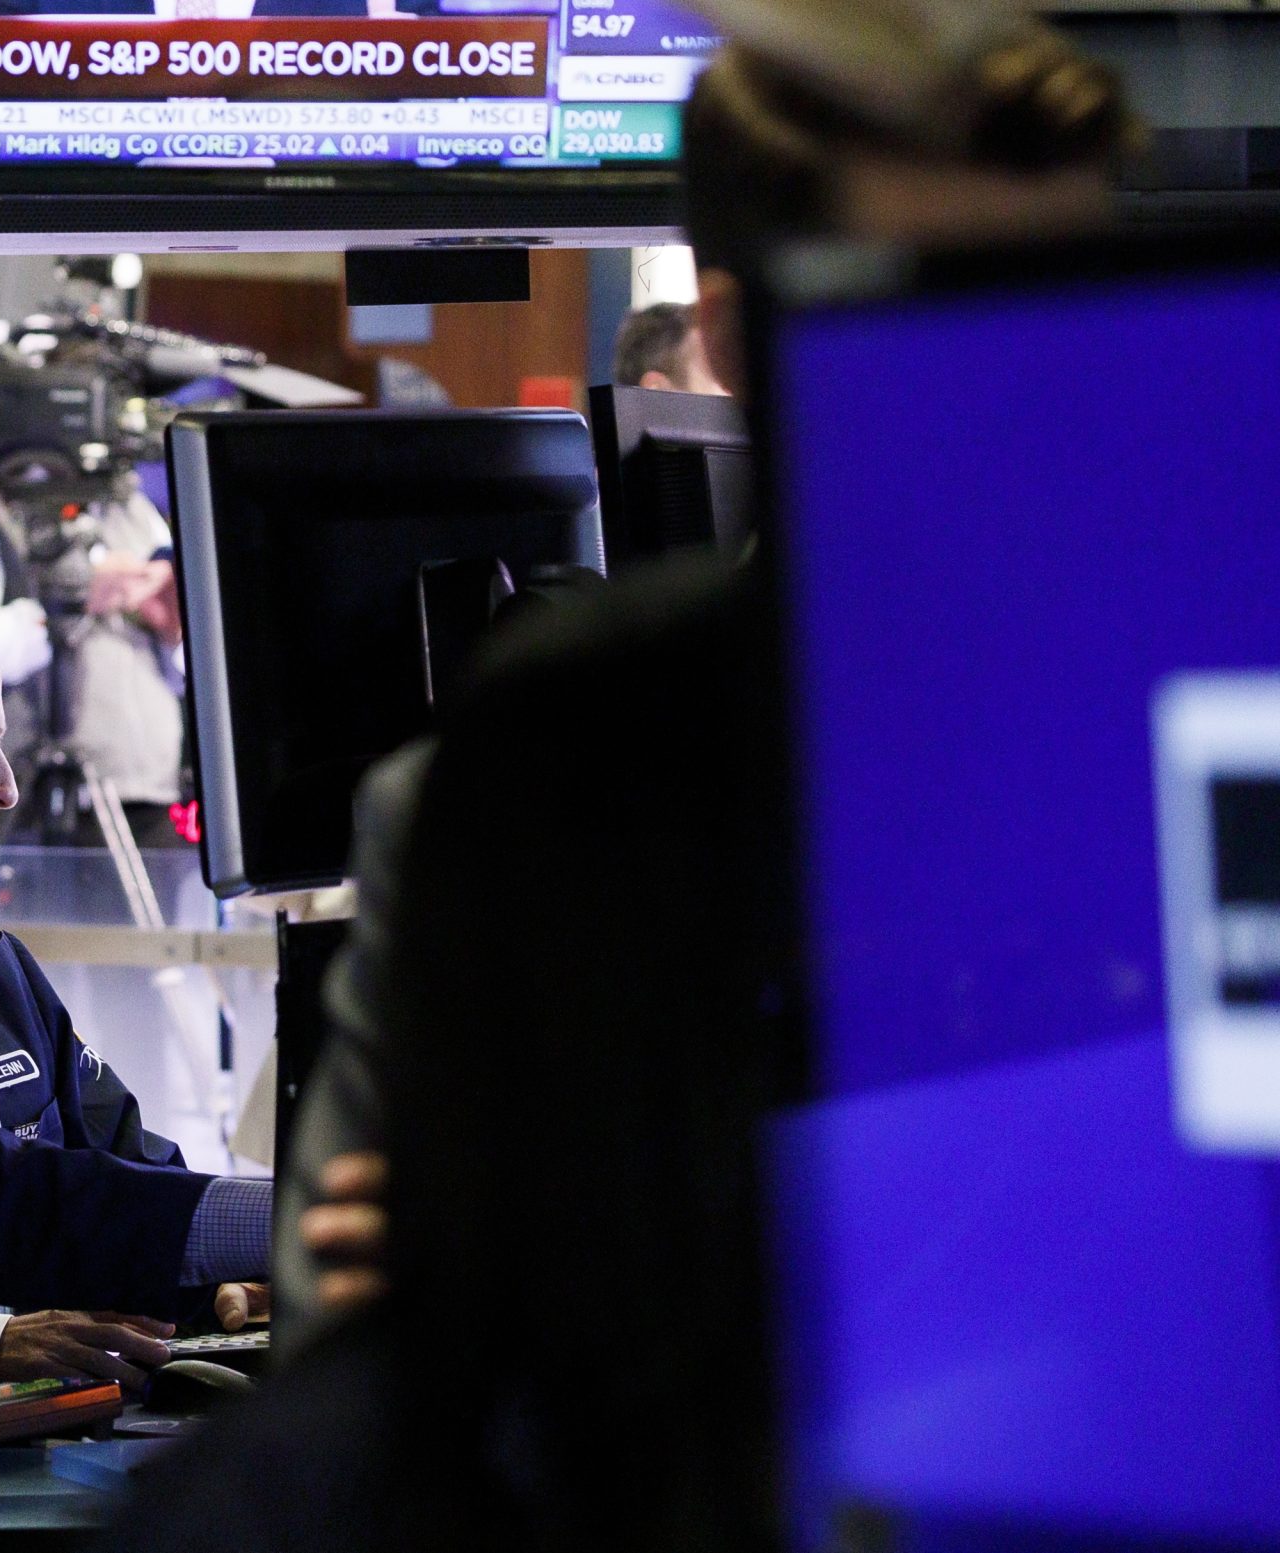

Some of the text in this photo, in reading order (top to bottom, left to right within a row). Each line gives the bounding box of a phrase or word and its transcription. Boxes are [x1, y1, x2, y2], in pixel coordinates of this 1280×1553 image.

[571, 14, 635, 38] 54.97
[88, 41, 160, 76] S&P
[168, 41, 240, 76] 500
[250, 41, 404, 77] RECORD
[413, 41, 536, 77] CLOSE
[596, 72, 665, 84] CNBC
[59, 106, 113, 124] MSCI
[121, 106, 185, 124] ACWI
[300, 106, 373, 125] 573.80
[383, 106, 440, 125] +0.43
[471, 107, 525, 125] MSCI
[563, 109, 622, 130] DOW
[6, 133, 62, 155] Mark
[67, 133, 121, 159] Hldg
[125, 134, 158, 156] Co
[162, 133, 249, 157] (CORE)
[253, 134, 316, 156] 25.02
[340, 134, 390, 156] 0.04
[417, 134, 505, 156] Invesco
[509, 134, 547, 156] QQ
[562, 132, 665, 155] 29,030.83
[14, 1124, 38, 1138] BUY
